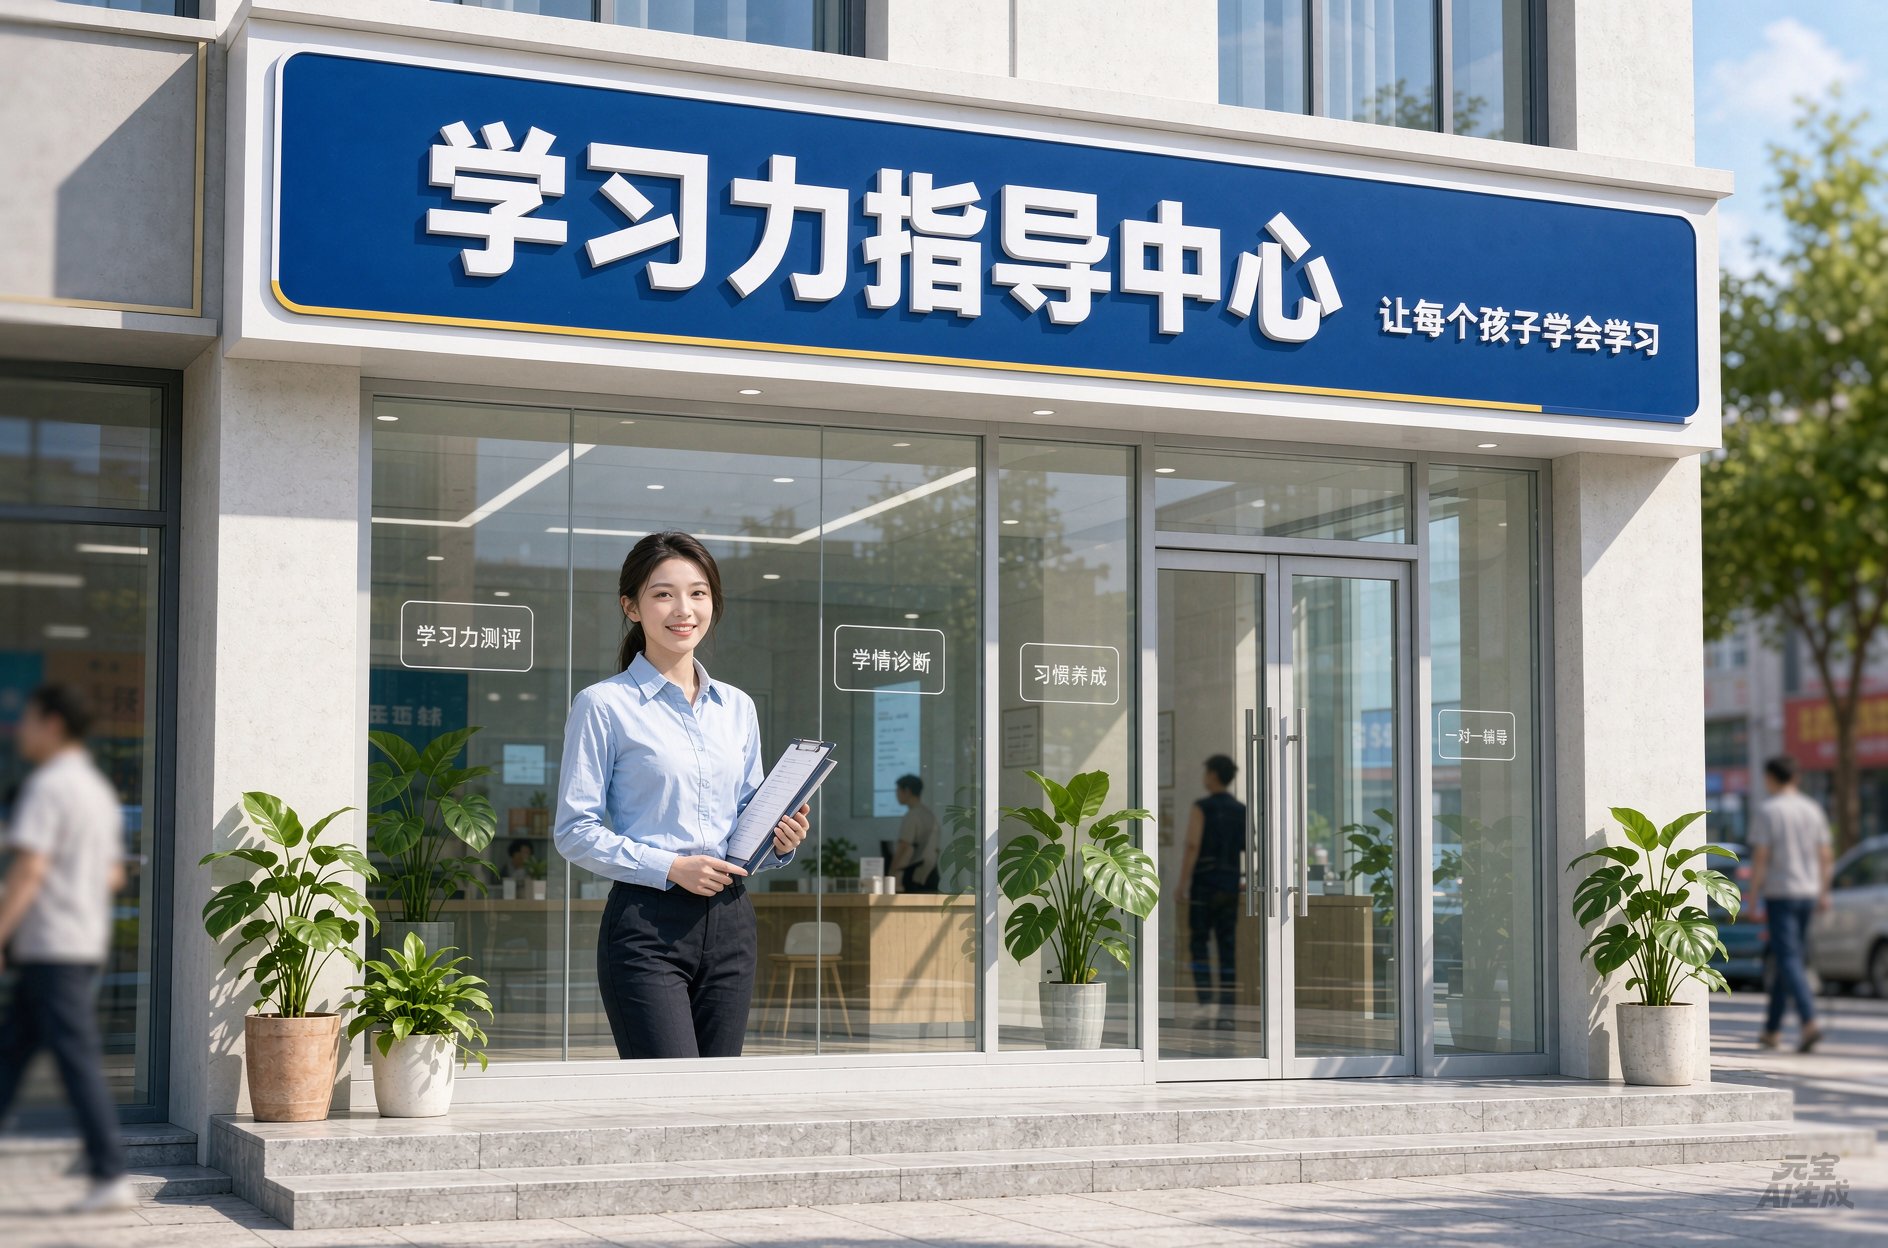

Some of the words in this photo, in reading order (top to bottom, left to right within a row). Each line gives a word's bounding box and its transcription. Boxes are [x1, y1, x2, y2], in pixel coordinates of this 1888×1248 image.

[427, 120, 1342, 343] 学习力指导中心
[1379, 296, 1659, 356] 让每个孩子学会学习
[416, 624, 521, 651] 学习力测评
[852, 649, 931, 674] 学情诊断
[1034, 664, 1107, 687] 习惯养成
